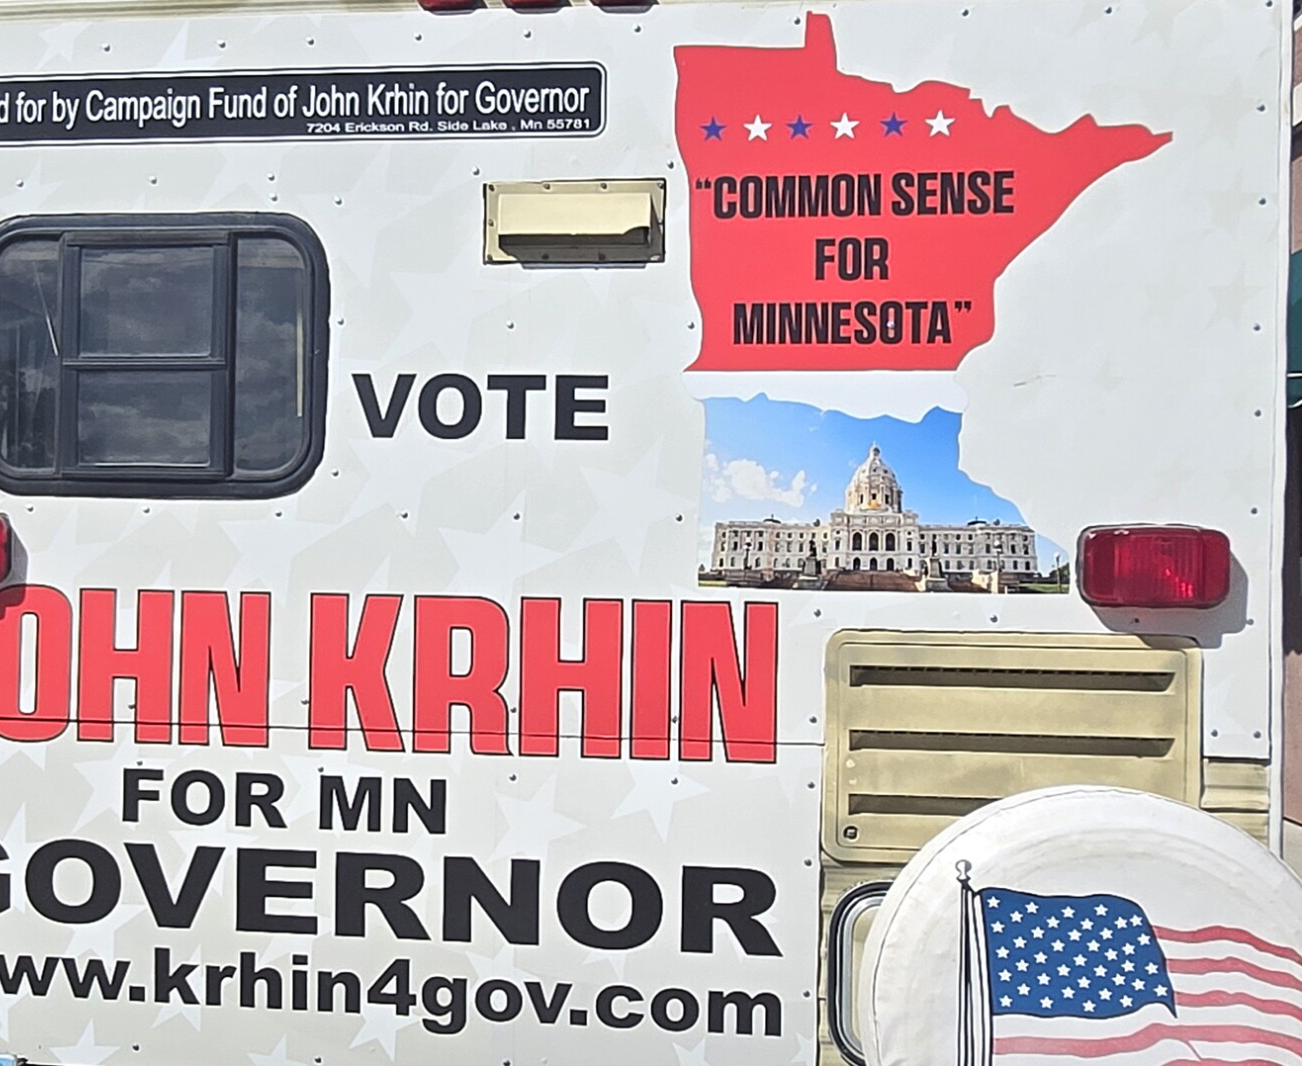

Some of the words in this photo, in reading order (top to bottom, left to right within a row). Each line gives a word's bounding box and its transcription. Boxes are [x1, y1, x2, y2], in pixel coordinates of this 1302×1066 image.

[16, 91, 47, 123] for
[52, 91, 80, 130] by
[85, 88, 201, 128] Campaign
[208, 86, 267, 119] Fund
[274, 85, 299, 118] of
[301, 84, 360, 117] John
[367, 82, 430, 116] Krhin
[435, 82, 470, 115] for
[475, 80, 590, 114] Governor
[306, 122, 341, 133] 7204
[344, 121, 406, 133] Erickson
[408, 121, 434, 132] Rd.
[437, 120, 469, 132] Side
[472, 120, 508, 131] Lake
[520, 119, 544, 130] Mn
[546, 118, 591, 130] 55781
[891, 170, 1015, 216] SENSE
[815, 237, 889, 281] FOR
[351, 373, 610, 441] VOTE
[309, 594, 778, 763] KRHIN
[122, 768, 287, 829] FOR
[318, 774, 447, 836] MN
